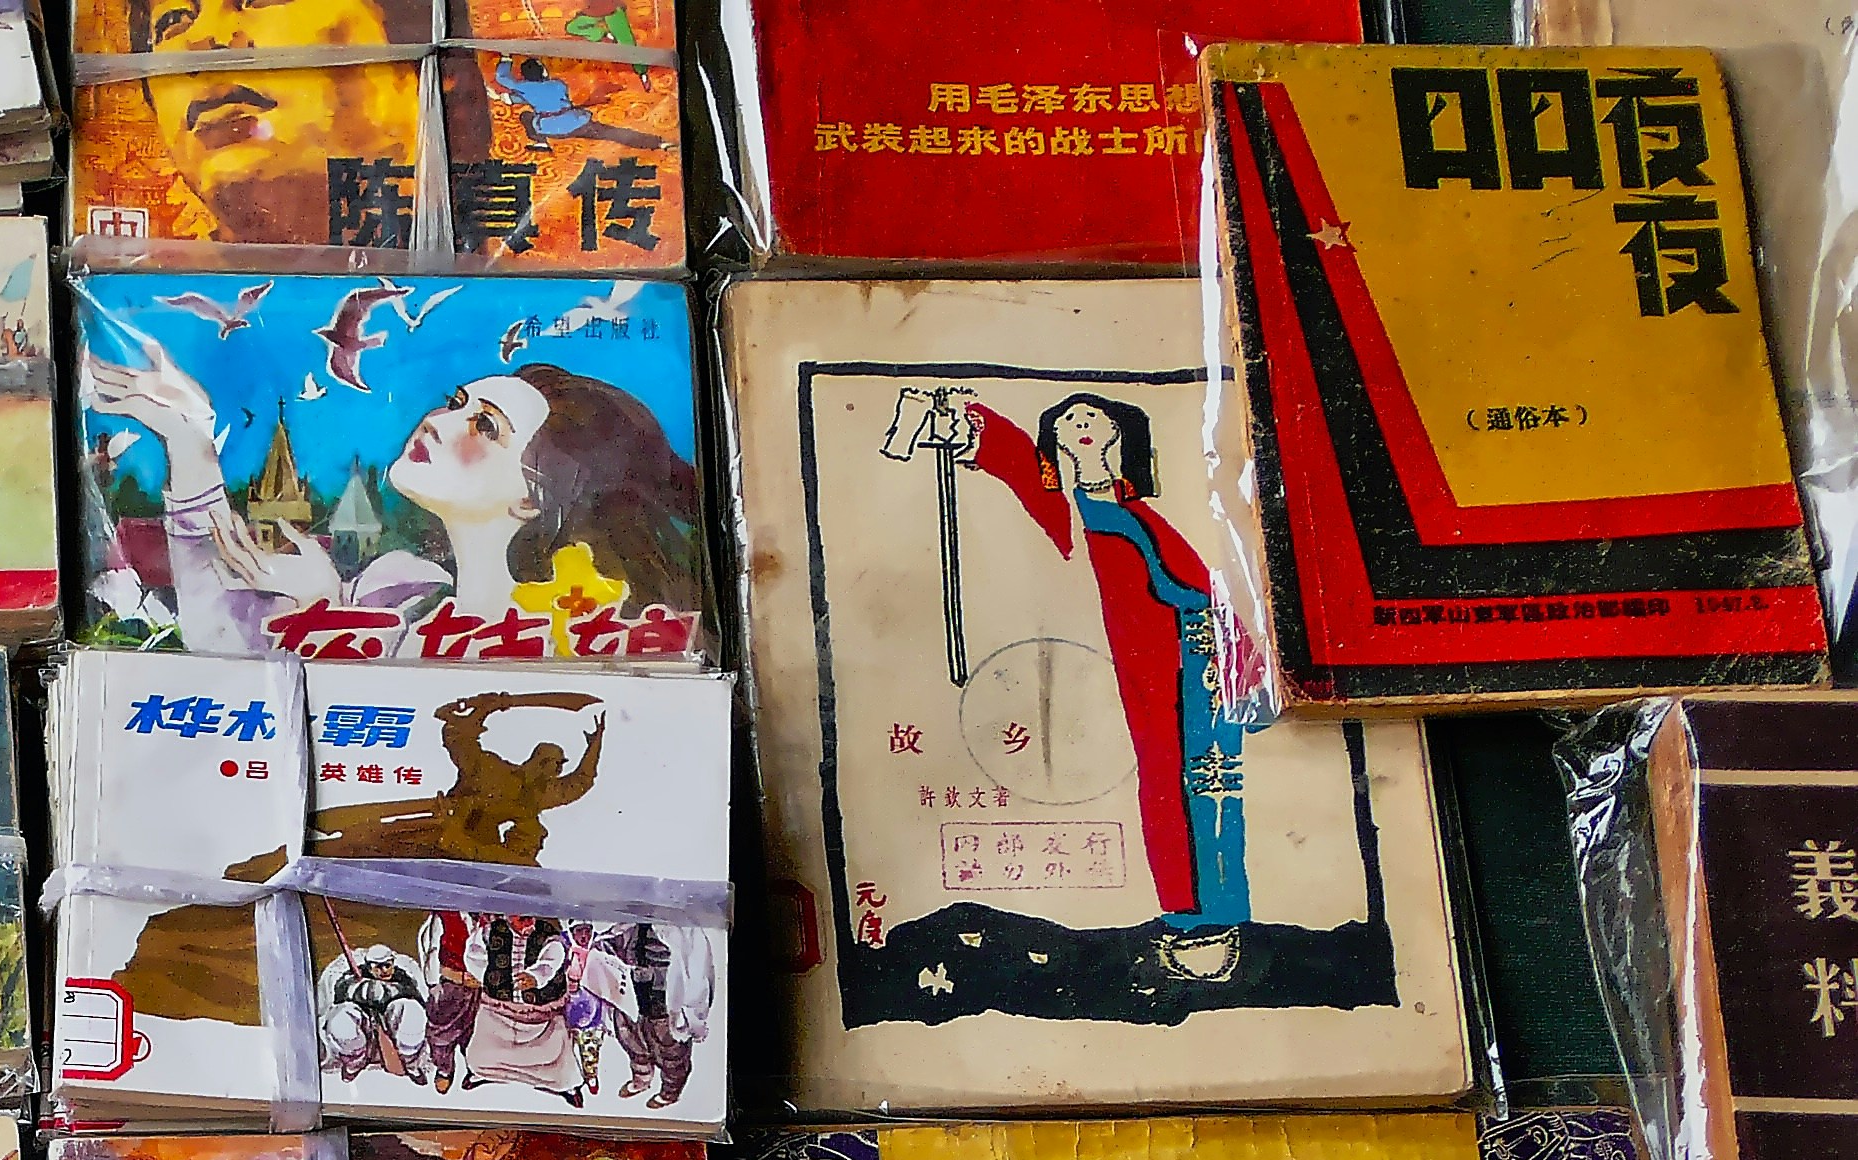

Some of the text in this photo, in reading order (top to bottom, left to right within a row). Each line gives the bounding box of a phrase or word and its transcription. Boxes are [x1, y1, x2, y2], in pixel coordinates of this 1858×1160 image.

[928, 83, 1203, 114] 用毛泽东思想
[814, 122, 1203, 156] 武装起来的战士所
[327, 157, 661, 253] 陈真传
[525, 315, 660, 340] 希望出版社
[245, 760, 423, 785] 吕英雄传
